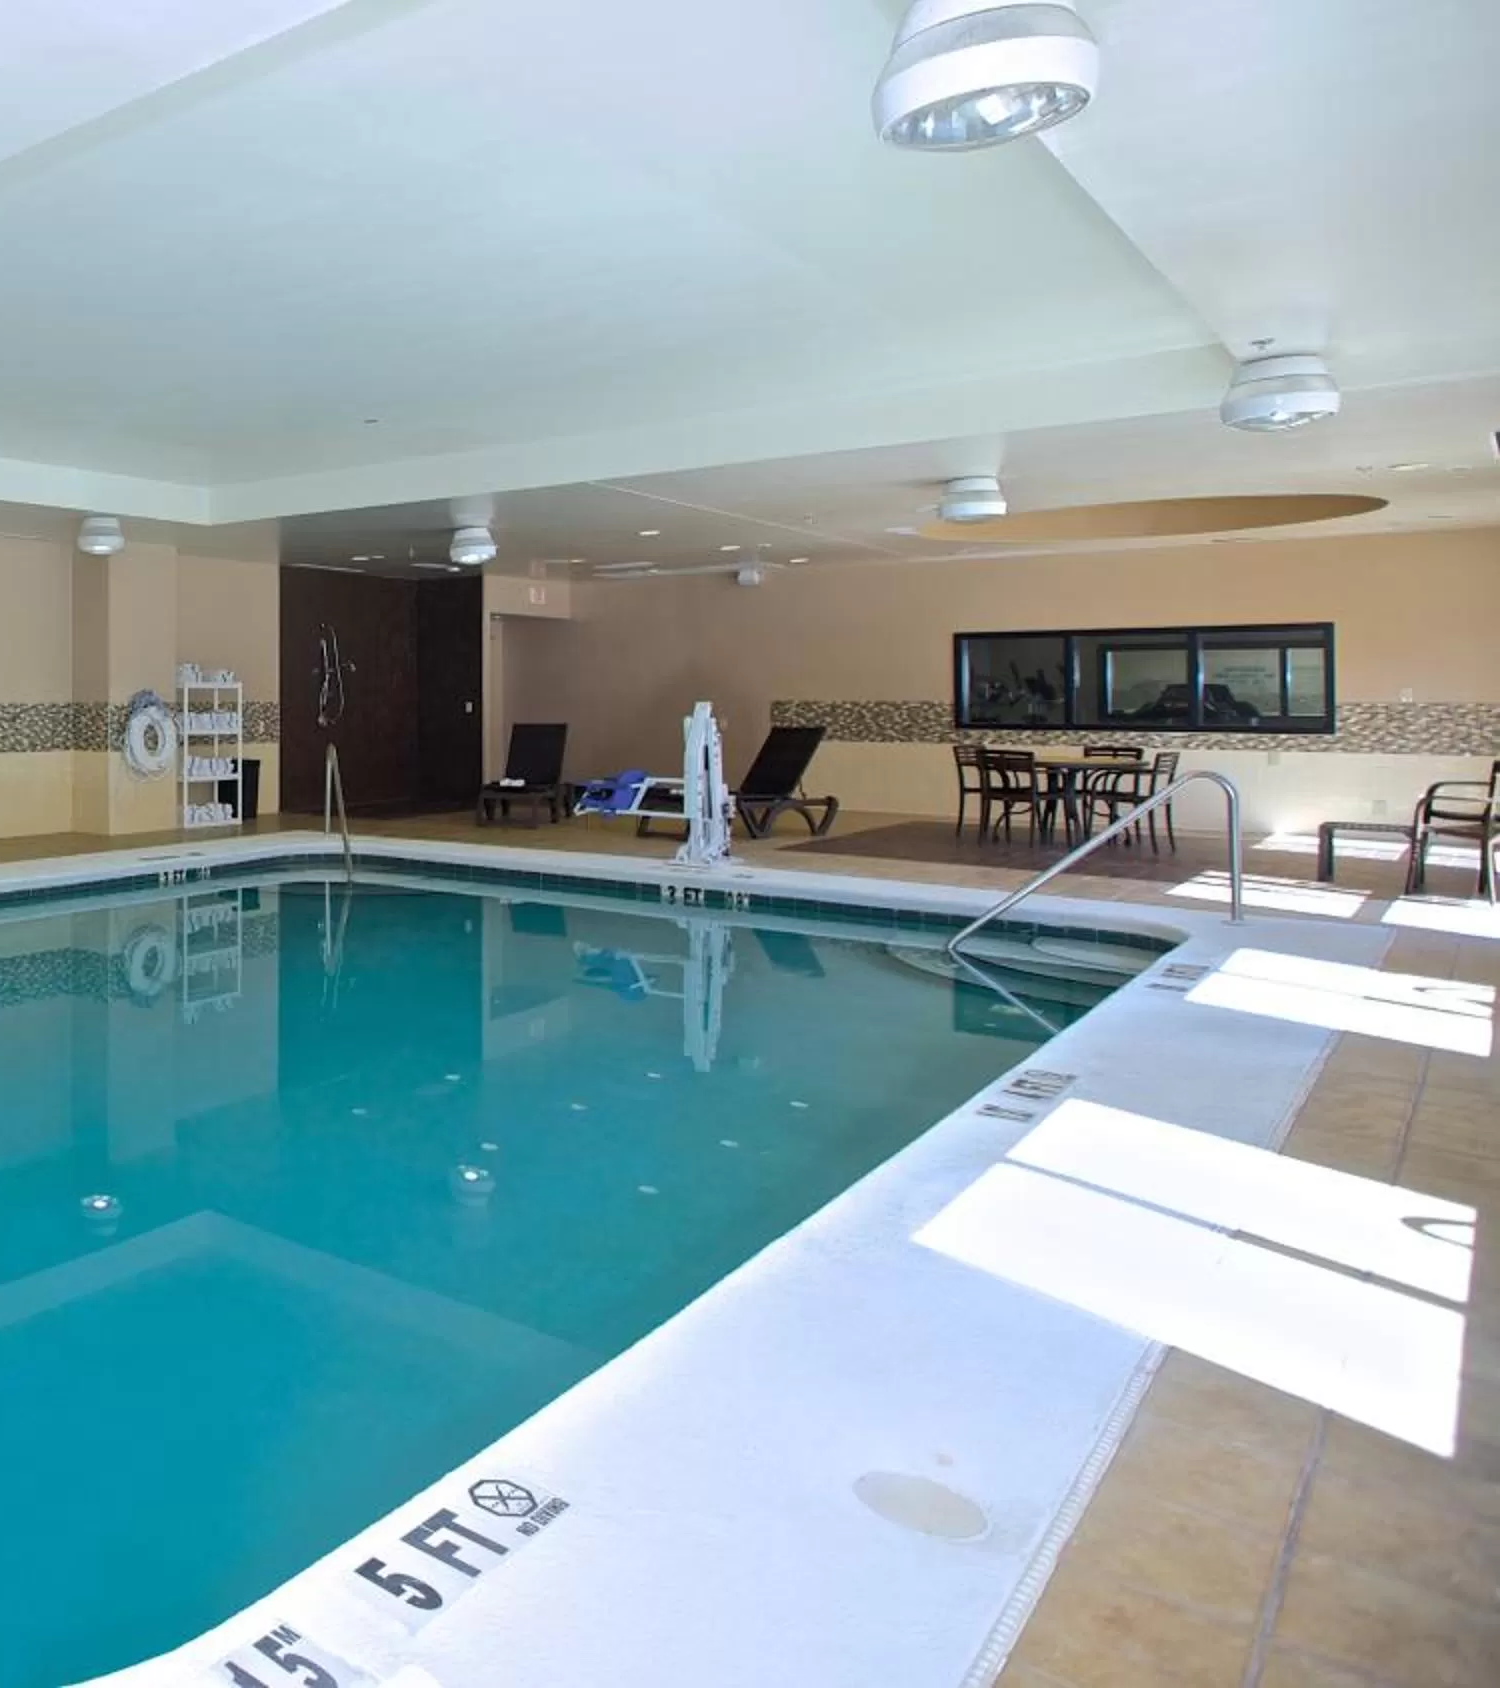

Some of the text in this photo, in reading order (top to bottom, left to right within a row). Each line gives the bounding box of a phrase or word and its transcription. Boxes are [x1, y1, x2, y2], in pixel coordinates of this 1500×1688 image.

[354, 1556, 444, 1610] 5
[400, 1507, 509, 1577] FT
[515, 1521, 540, 1537] NO
